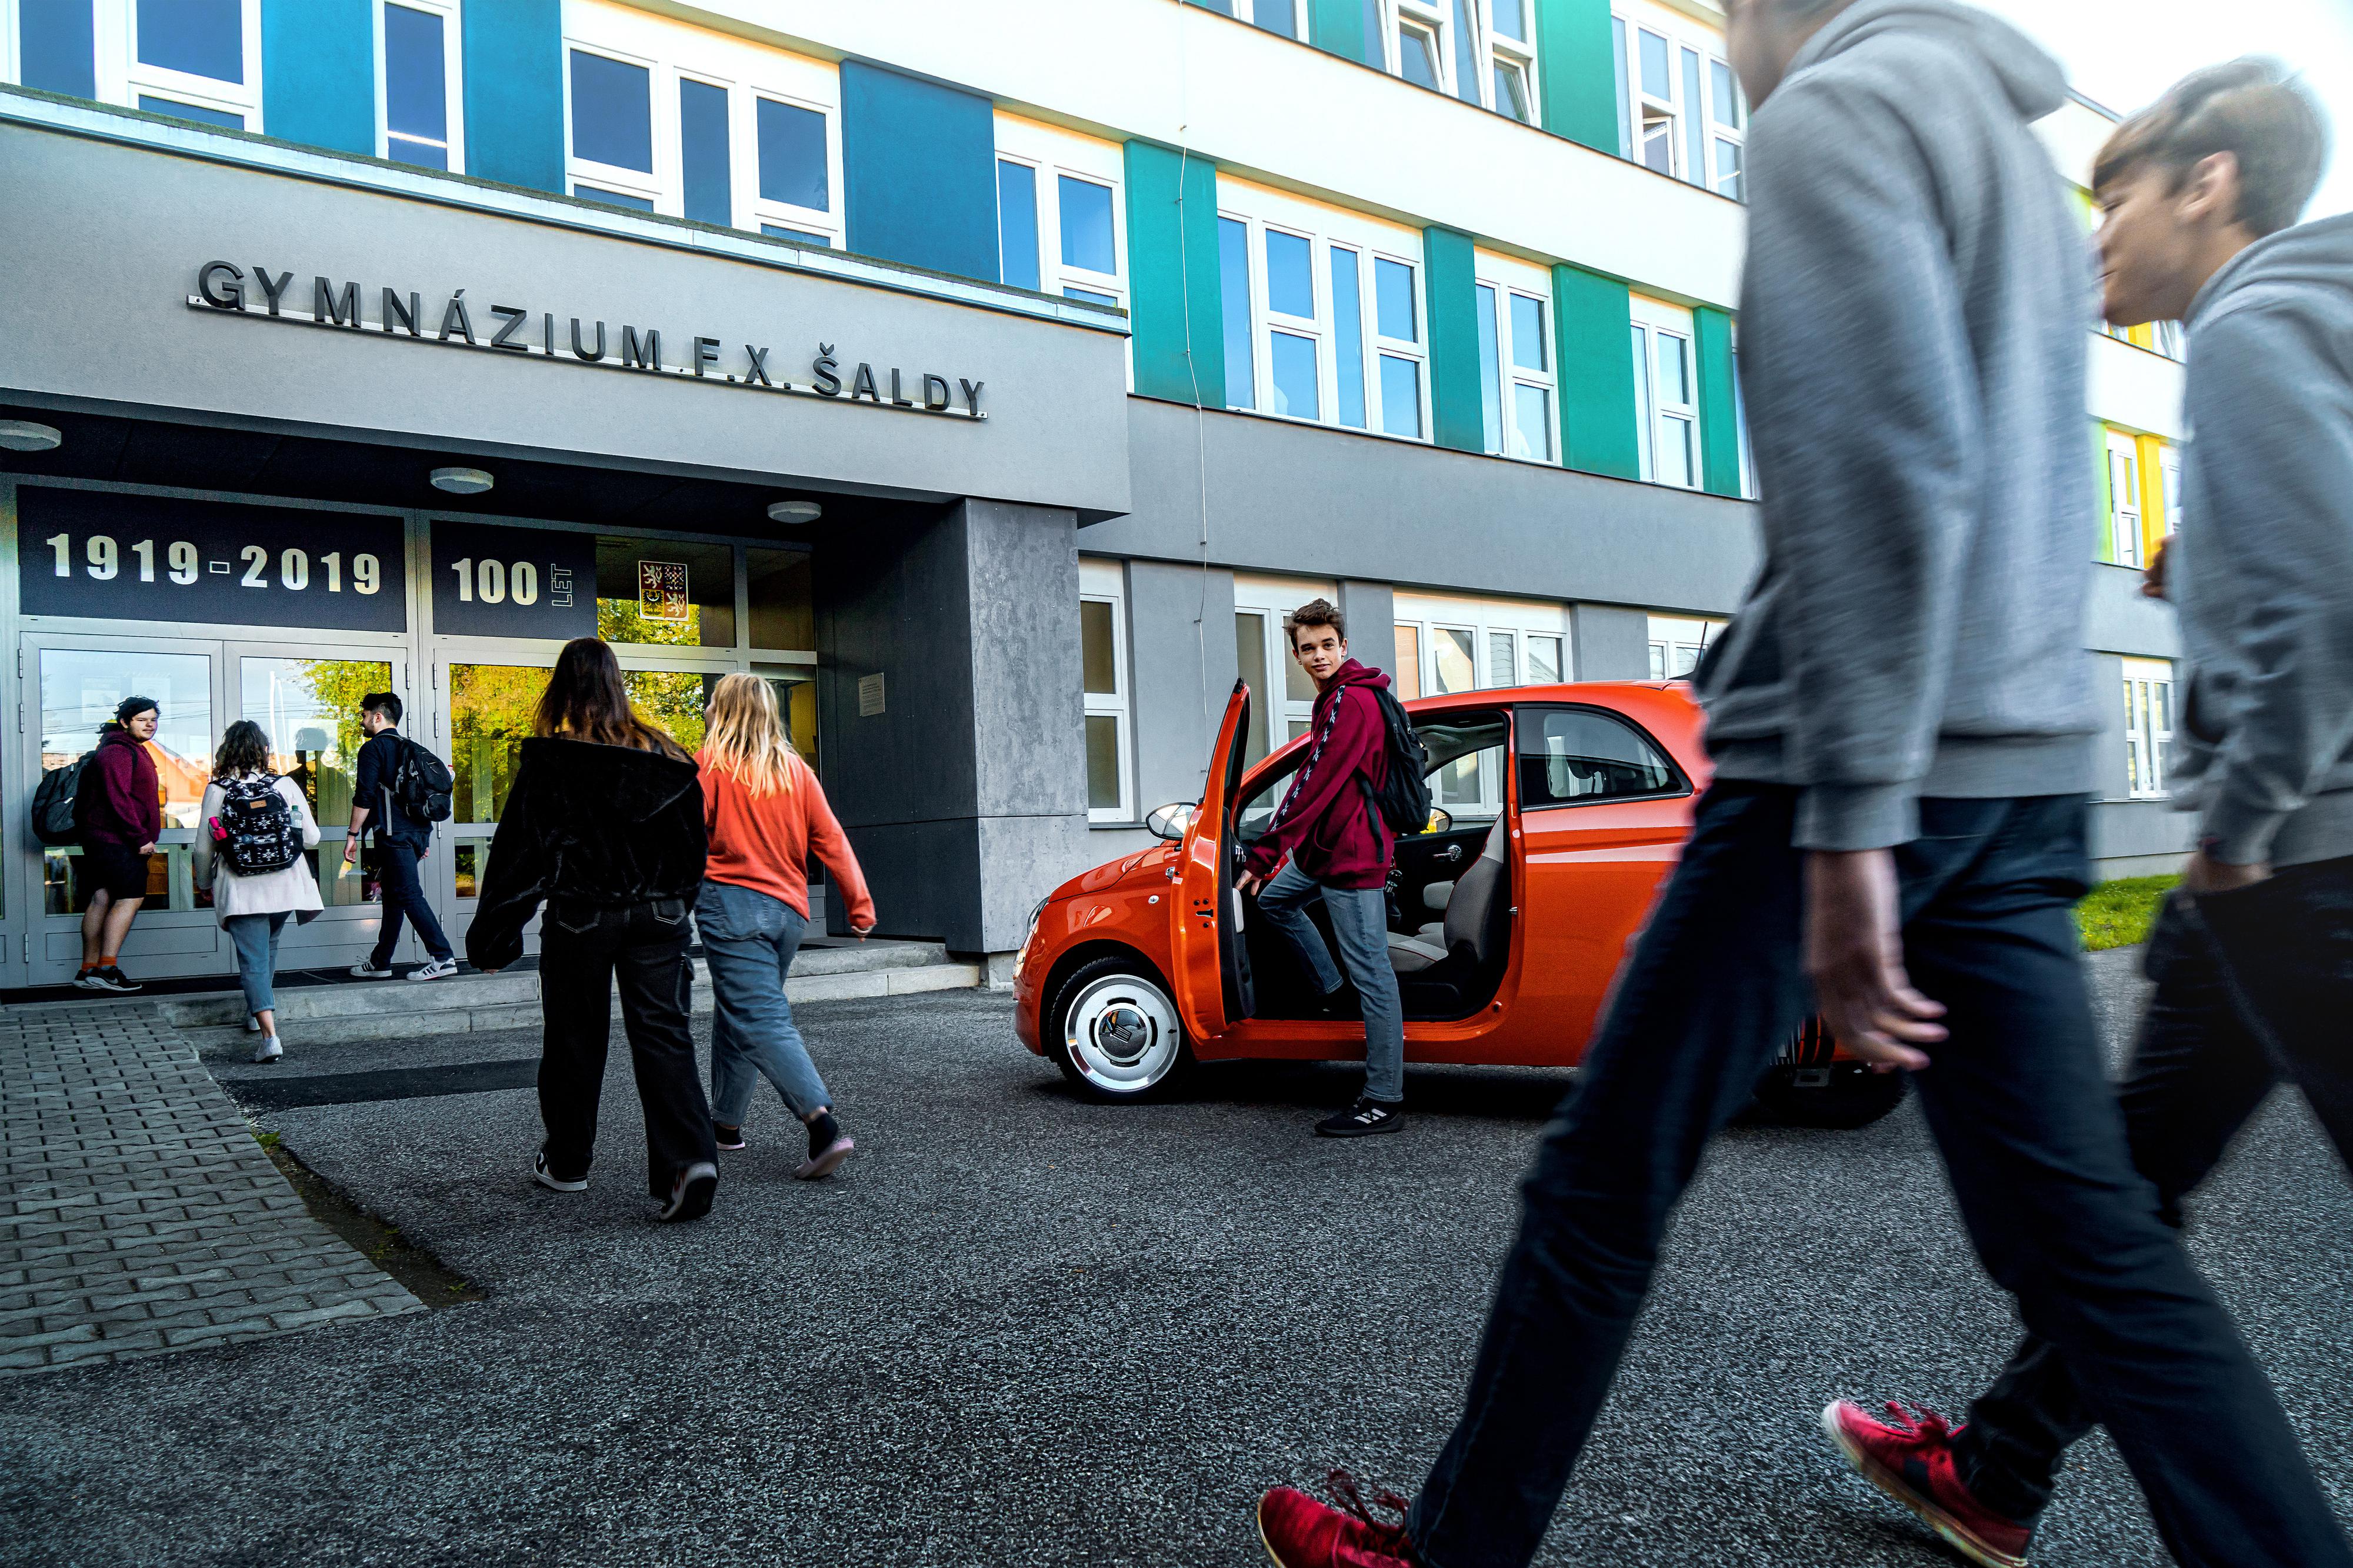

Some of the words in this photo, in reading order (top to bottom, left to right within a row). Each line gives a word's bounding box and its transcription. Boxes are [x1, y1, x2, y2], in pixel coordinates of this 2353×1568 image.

[198, 260, 662, 371] GYMNÁZIUM
[811, 341, 985, 416] ŠALDY
[451, 558, 538, 605] 100
[551, 563, 572, 606] LET
